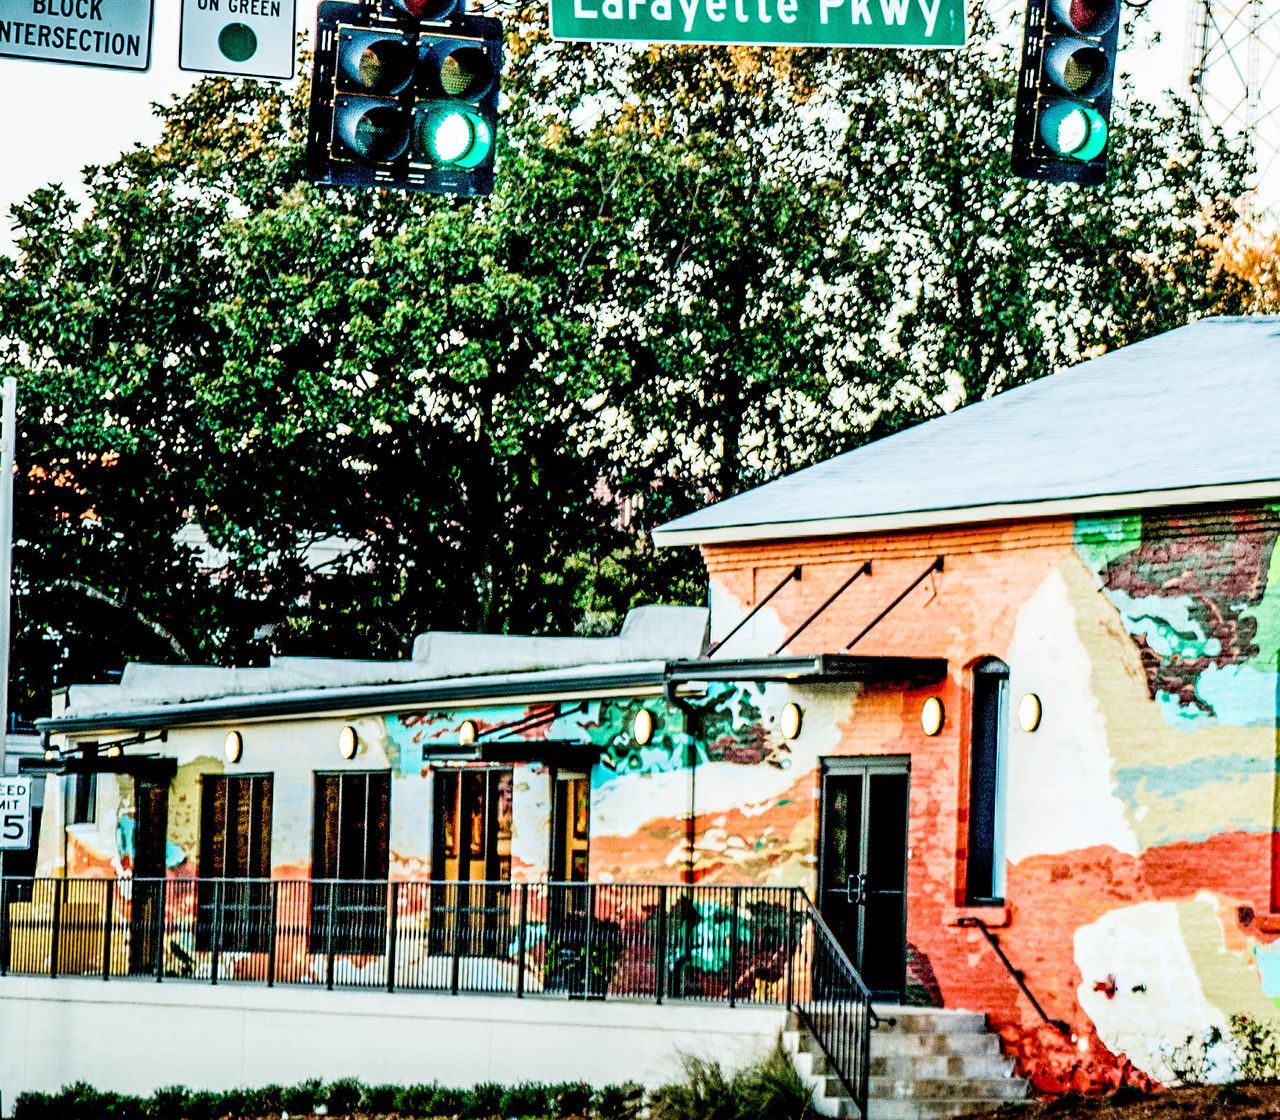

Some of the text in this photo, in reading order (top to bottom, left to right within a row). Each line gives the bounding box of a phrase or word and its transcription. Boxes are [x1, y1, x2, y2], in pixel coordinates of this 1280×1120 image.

[33, 0, 102, 20] BLOCK
[197, 0, 280, 17] ON GREEN
[820, 0, 941, 37] Pkwy
[0, 21, 140, 56] NTERSECTION
[3, 815, 24, 839] 5
